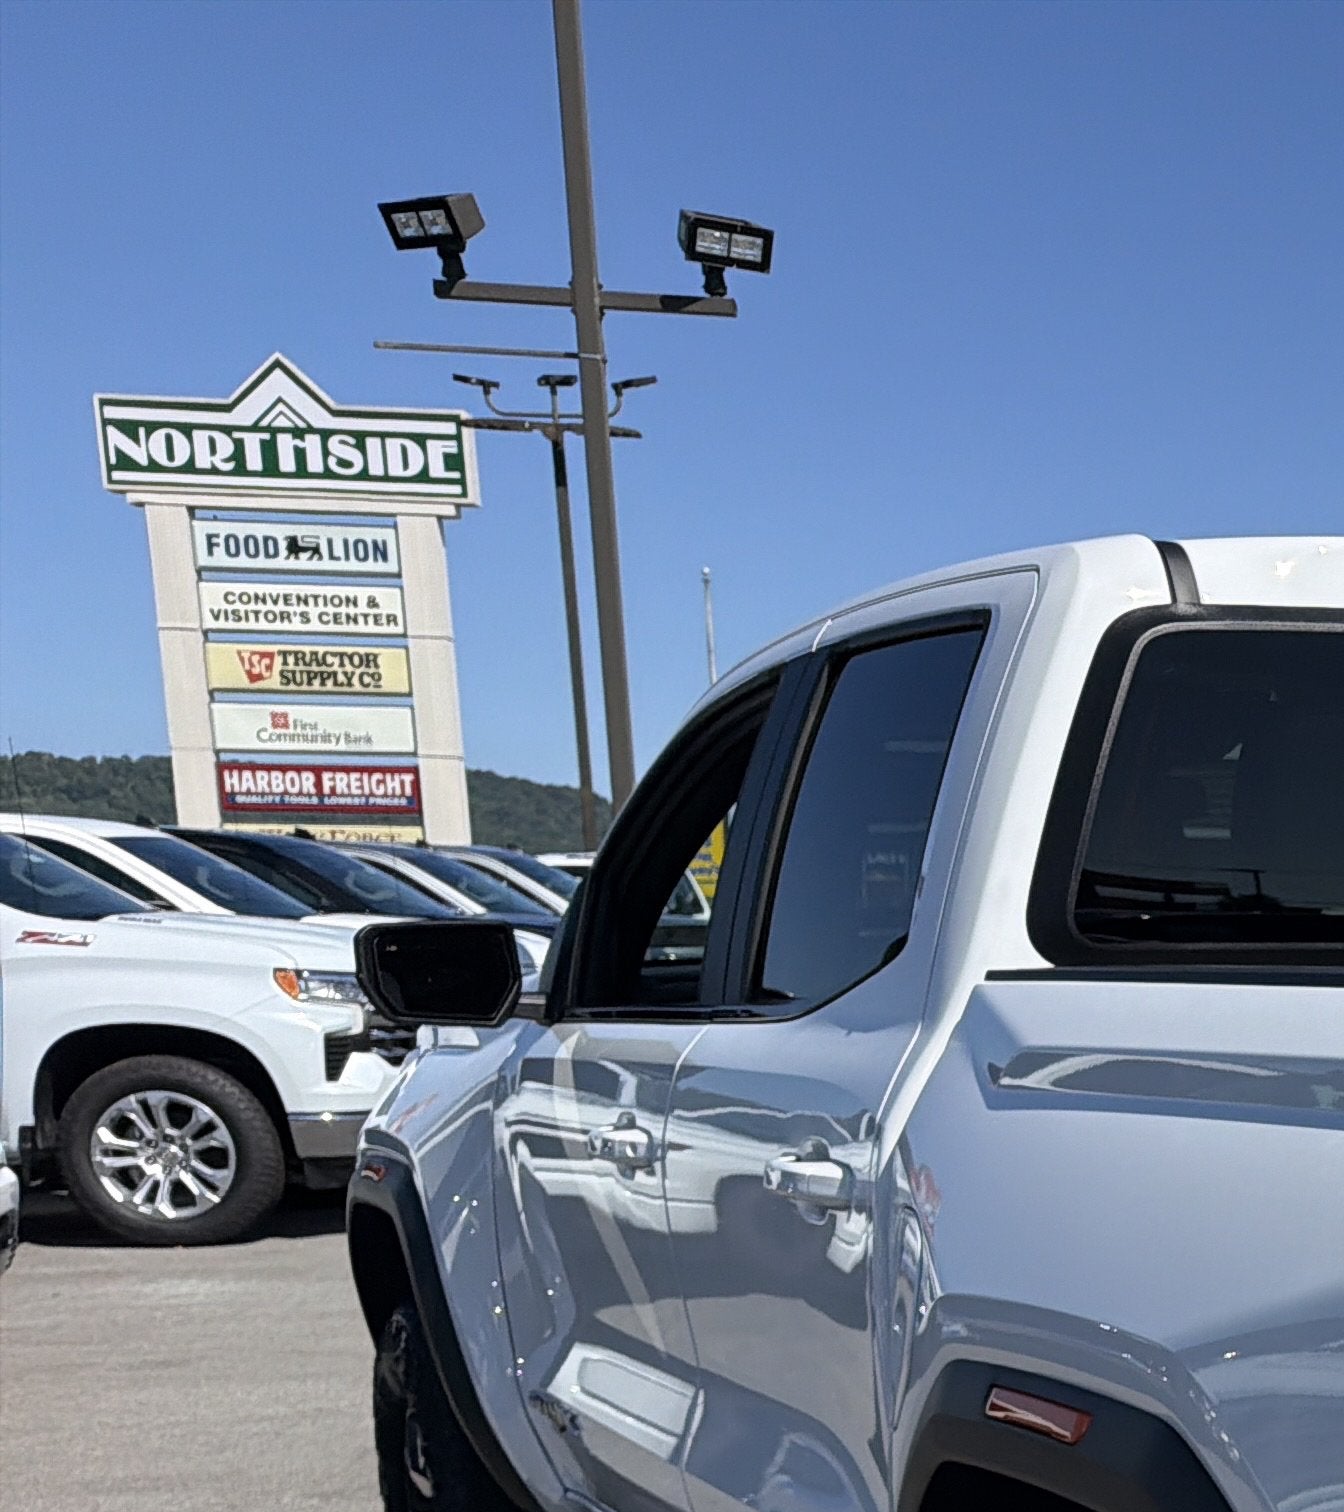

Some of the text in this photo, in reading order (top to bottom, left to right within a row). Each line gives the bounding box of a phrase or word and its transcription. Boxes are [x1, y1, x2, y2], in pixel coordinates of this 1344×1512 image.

[106, 425, 462, 479] NORTHSIDE
[205, 533, 389, 563] FOOD LION
[223, 591, 380, 609] CONVENTION &
[209, 608, 399, 627] VISITOR'S CENTER
[240, 651, 272, 677] TSC
[277, 650, 381, 670] TRACTOR
[279, 670, 356, 687] SUPPLY
[256, 727, 373, 747] Community Bank
[223, 768, 415, 796] HARBOR FREIGHT
[235, 794, 281, 804] QUALITY
[284, 795, 318, 805] TOOLS
